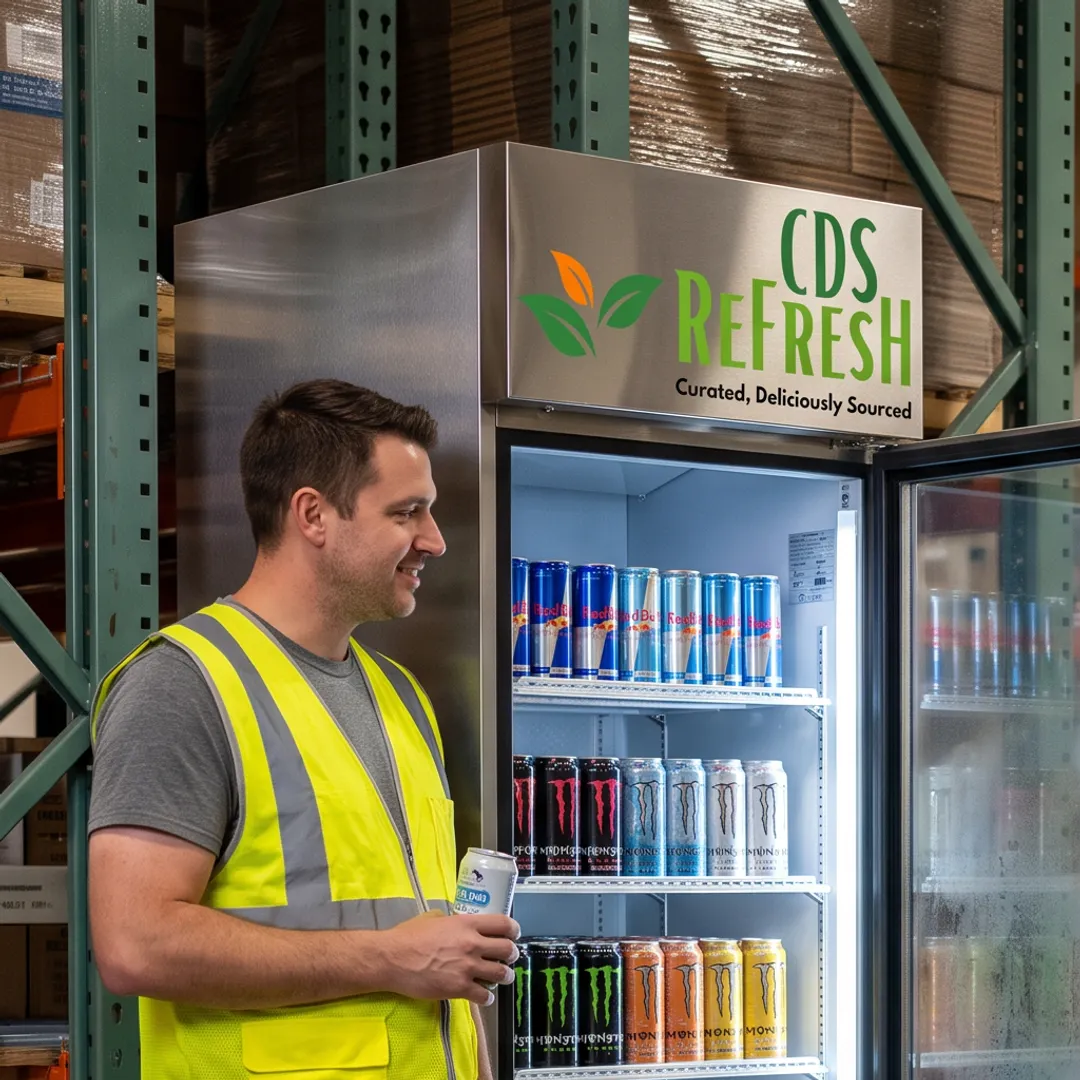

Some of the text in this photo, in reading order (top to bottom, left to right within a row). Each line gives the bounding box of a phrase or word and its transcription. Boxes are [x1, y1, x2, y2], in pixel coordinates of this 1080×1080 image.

[781, 208, 878, 303] CDS
[675, 378, 912, 419] Curated, Deliciously Sourced
